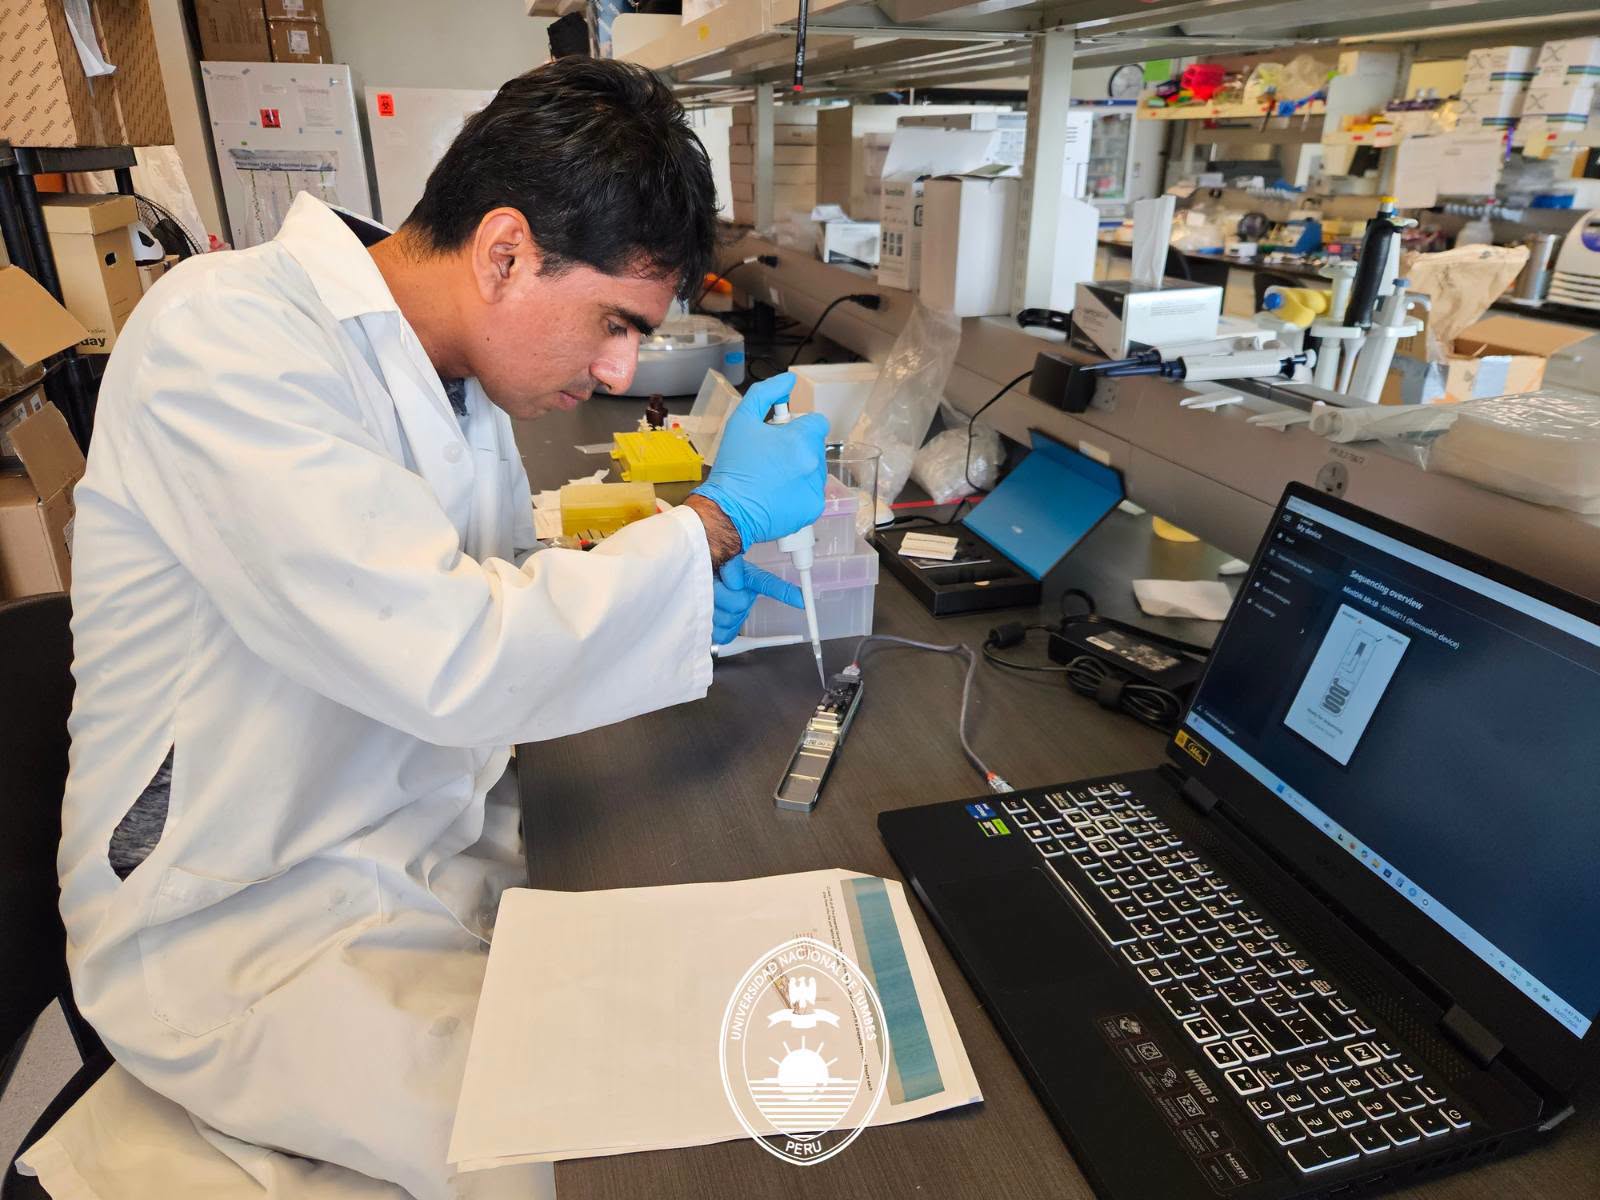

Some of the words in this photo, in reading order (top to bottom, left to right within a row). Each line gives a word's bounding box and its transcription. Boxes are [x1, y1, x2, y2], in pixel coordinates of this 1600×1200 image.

[14, 23, 30, 40] QIAGEN
[10, 46, 26, 63] QIAGEN
[33, 38, 48, 55] QIAGEN
[29, 61, 43, 78] QIAGEN
[8, 70, 23, 86] QIAGEN
[47, 75, 62, 91] QIAGEN
[4, 92, 18, 108] QIAGEN
[26, 84, 41, 100] QIAGEN
[22, 106, 37, 122] QIAGEN
[44, 99, 59, 114] QIAGEN
[1, 114, 16, 131] QIAGEN
[40, 120, 55, 137] QIAGEN
[19, 129, 34, 145] QIAGEN
[79, 336, 106, 348] day
[1349, 570, 1390, 595] Sequencing
[1389, 590, 1424, 610] overview
[1438, 634, 1460, 650] device)
[1072, 812, 1080, 820] A
[1234, 957, 1244, 966] P
[1185, 1069, 1212, 1100] NITRO
[1320, 1086, 1331, 1094] 5
[1261, 1101, 1272, 1109] 0
[1289, 1094, 1302, 1102] 2
[1371, 1102, 1383, 1110] 9
[1311, 1117, 1323, 1126] 3
[1342, 1110, 1354, 1118] 6
[1225, 1153, 1249, 1179] HDMI
